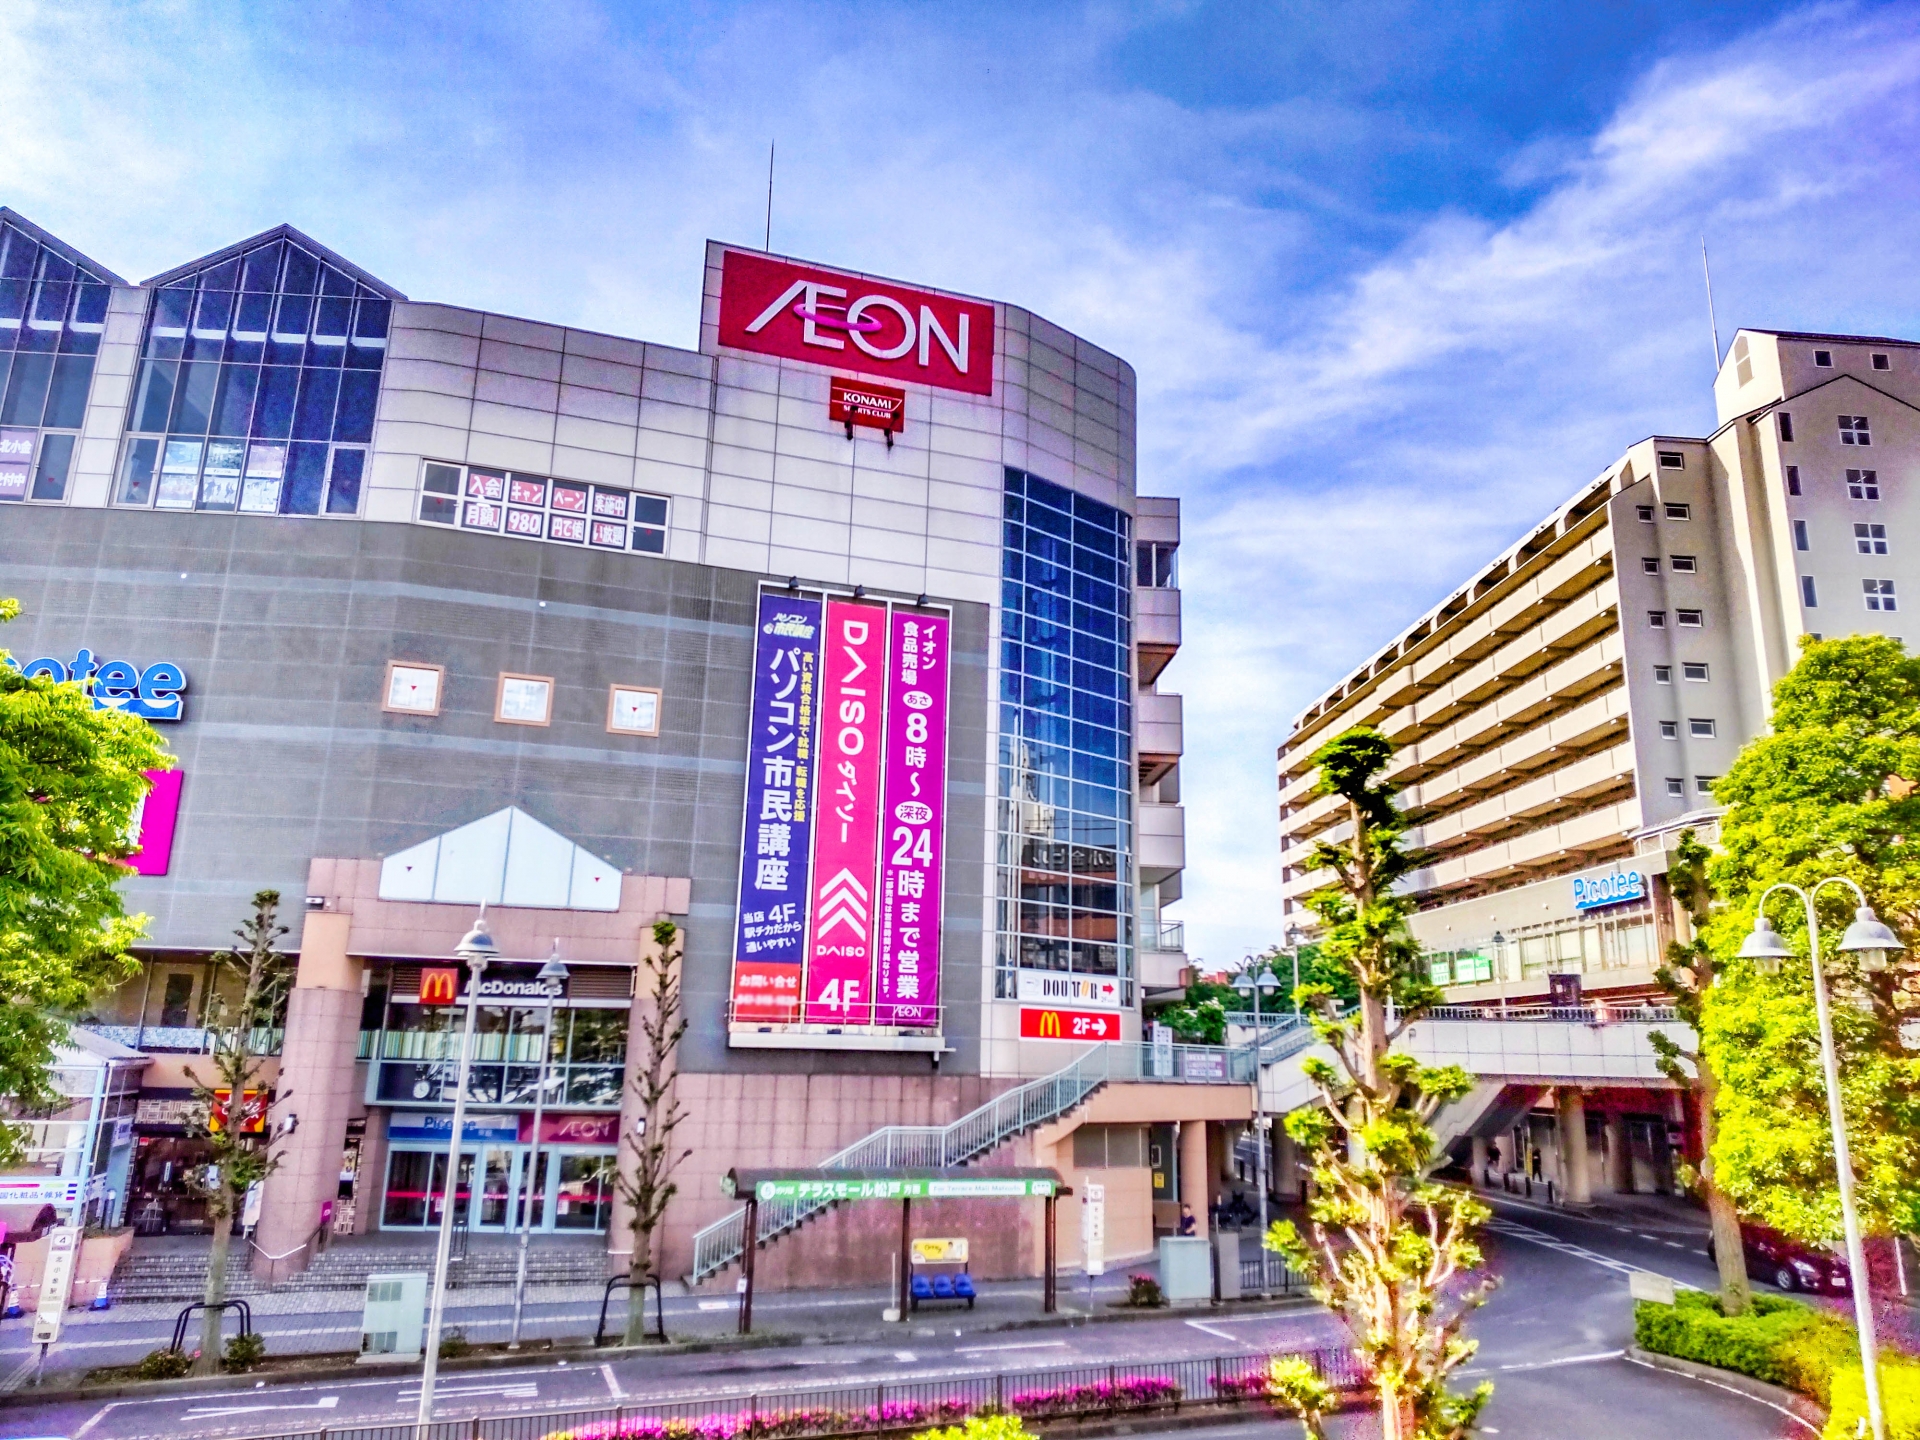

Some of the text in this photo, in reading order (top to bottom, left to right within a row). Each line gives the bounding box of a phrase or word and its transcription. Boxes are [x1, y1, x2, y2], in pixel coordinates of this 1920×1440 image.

[843, 392, 892, 409] KONAMI
[843, 404, 891, 418] SPRTS CLUB
[0, 439, 33, 454] 北小金
[901, 621, 919, 686] 食品売場
[922, 624, 937, 670] イオン
[3, 648, 187, 709] otee
[907, 694, 930, 707] あさ
[754, 647, 801, 891] パソコン市民講座
[835, 760, 859, 843] ダイソー
[898, 804, 930, 822] 深夜
[1573, 870, 1640, 903] Picotee
[743, 902, 797, 925] 当店 4F
[891, 826, 934, 1000] 24時まで営業
[743, 920, 803, 939] 駅チカだから
[745, 936, 797, 954] 通いやすい
[816, 945, 866, 957] DAISO
[463, 980, 564, 996] cDonals
[738, 974, 798, 989] お問い合せ
[1043, 978, 1098, 1000] DOUTOR
[818, 978, 860, 1012] 4F
[1072, 1017, 1091, 1035] 2F
[424, 1116, 477, 1131] Picoee
[799, 1181, 901, 1198] テラスモール松戸
